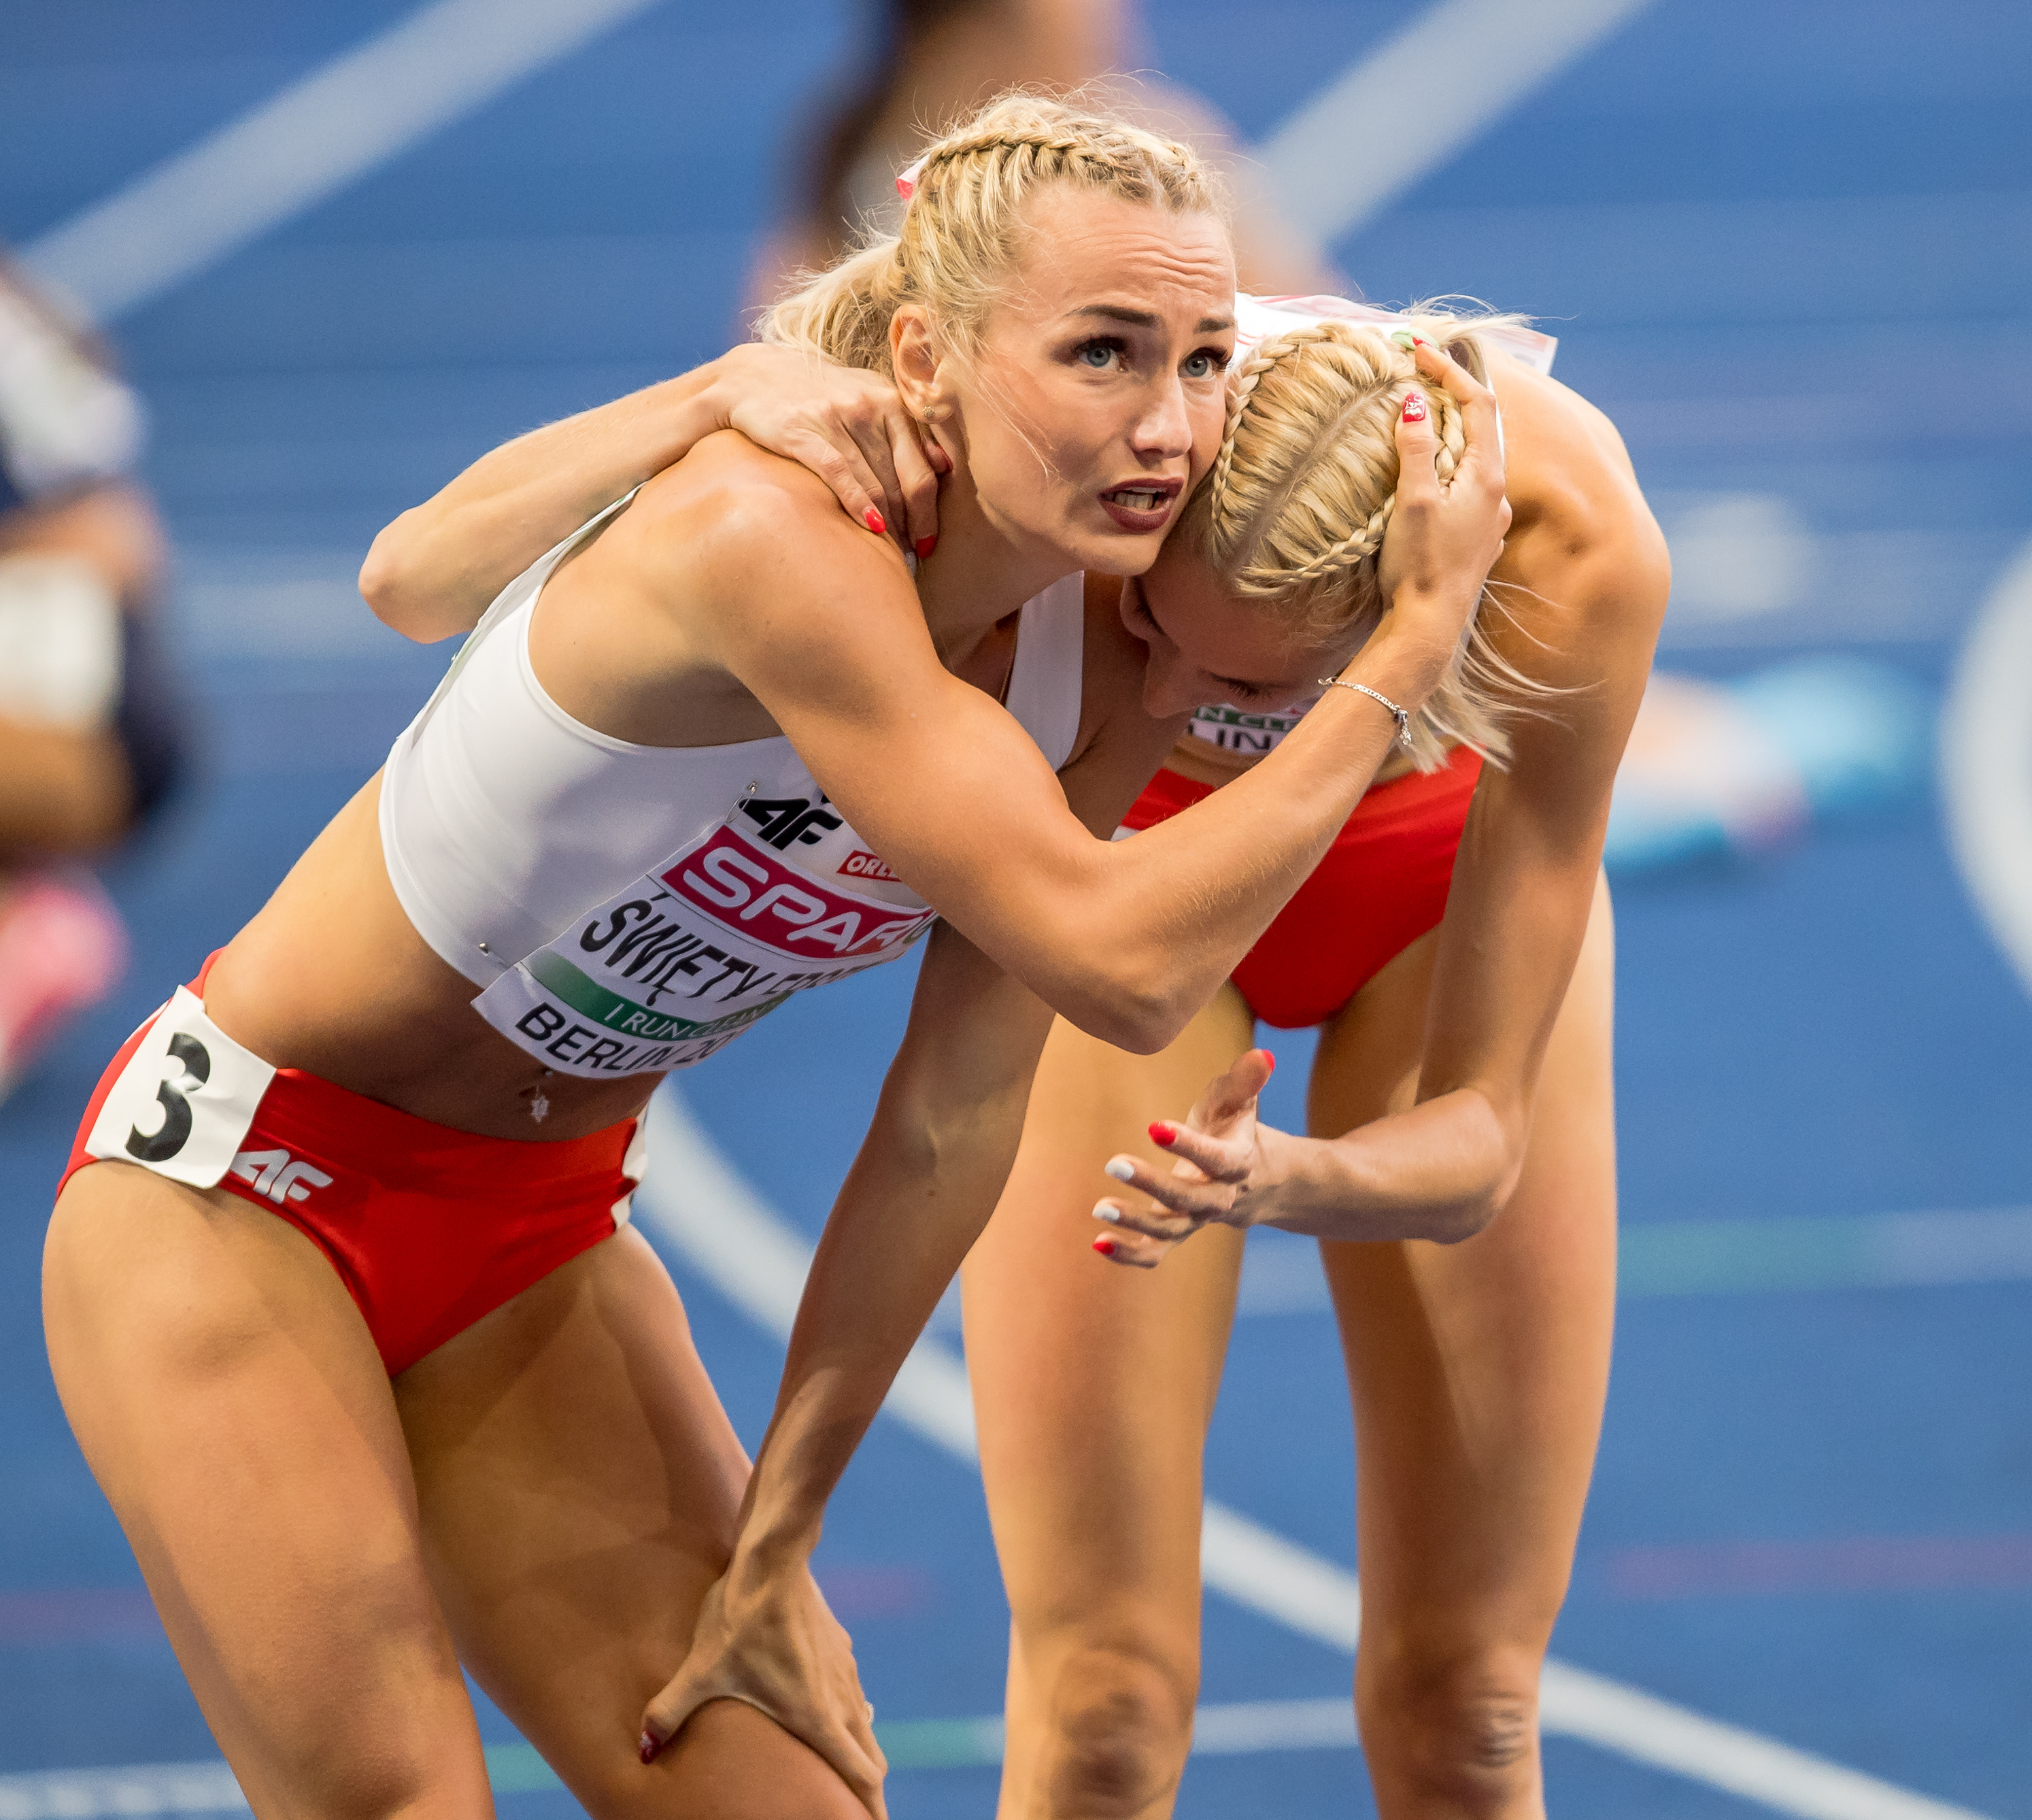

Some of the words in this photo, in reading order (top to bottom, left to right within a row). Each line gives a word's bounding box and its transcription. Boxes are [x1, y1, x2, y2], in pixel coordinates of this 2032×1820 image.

[514, 1000, 691, 1071] BERLIN
[621, 1010, 691, 1039] RUN
[124, 1031, 212, 1162] 3
